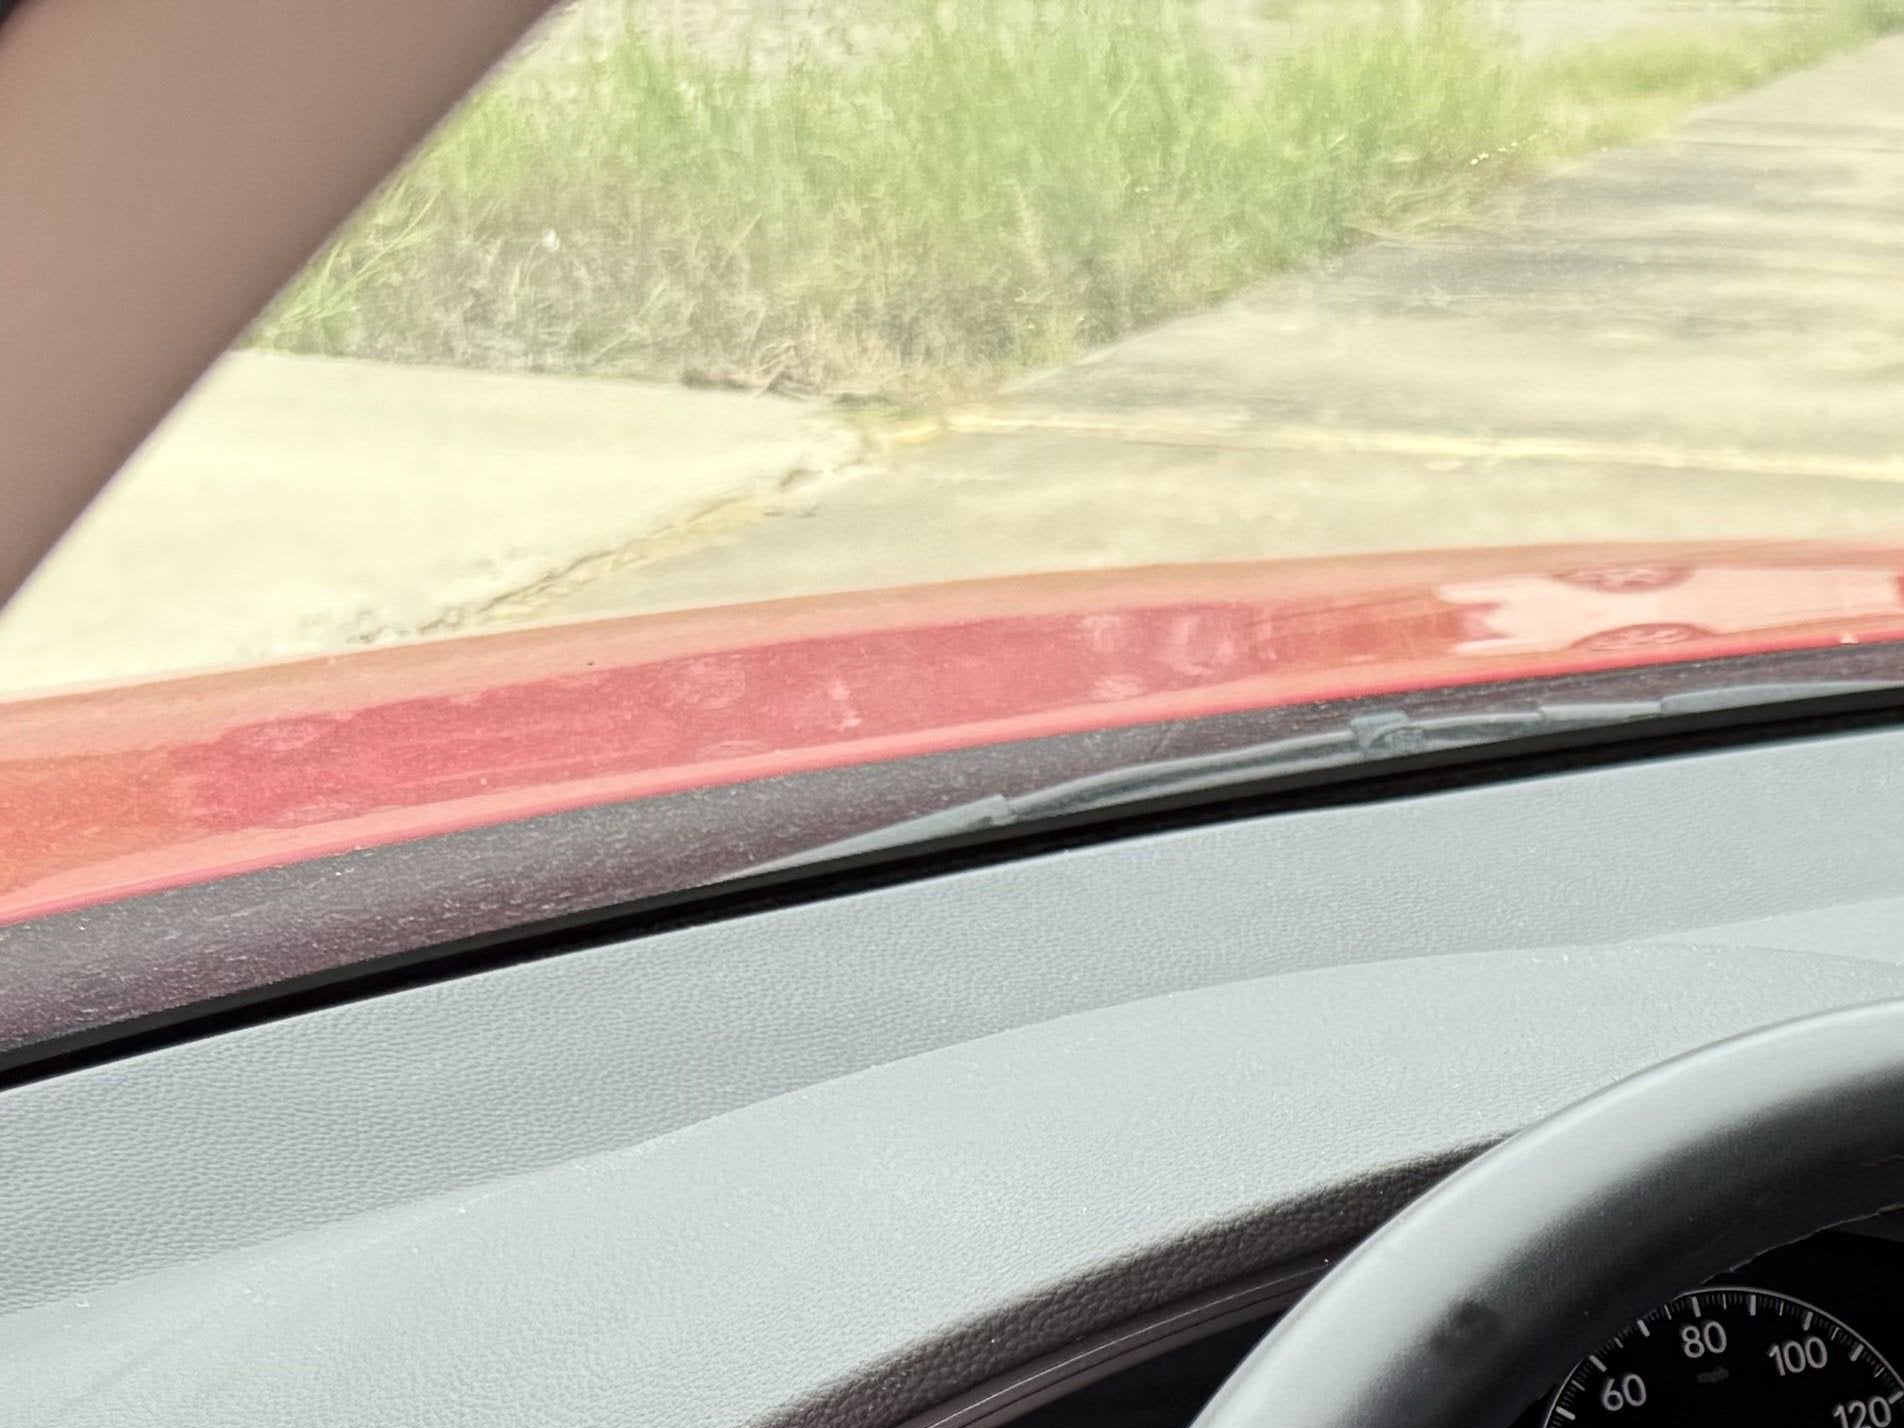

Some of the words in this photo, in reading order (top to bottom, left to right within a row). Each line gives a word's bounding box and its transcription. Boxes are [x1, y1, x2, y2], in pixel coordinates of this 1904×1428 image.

[1680, 1320, 1728, 1359] 80
[1767, 1335, 1829, 1377] 100
[1601, 1373, 1648, 1412] 60
